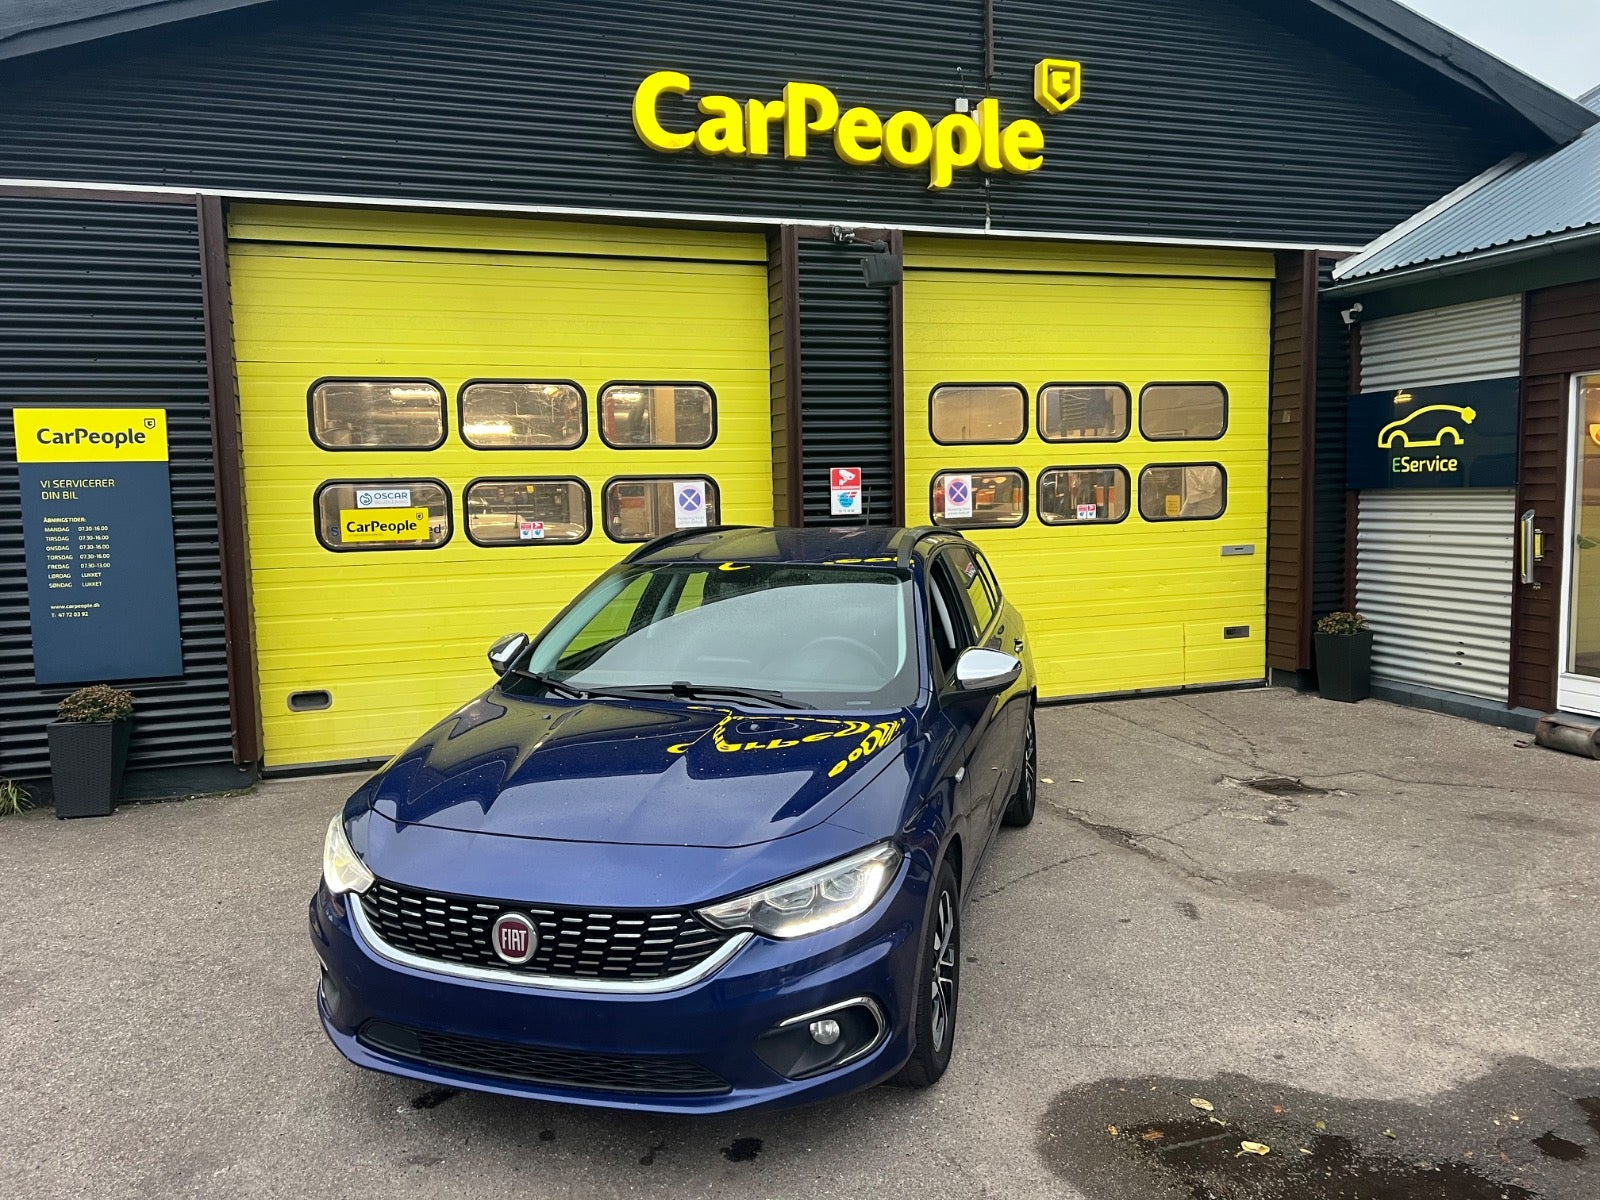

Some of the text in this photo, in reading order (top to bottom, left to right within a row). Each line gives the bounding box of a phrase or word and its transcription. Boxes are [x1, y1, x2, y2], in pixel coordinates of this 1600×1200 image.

[632, 71, 1044, 191] CarPeople
[36, 428, 146, 449] CarPeople
[1392, 455, 1458, 473] EService
[40, 479, 115, 488] VI SERVICERER
[41, 491, 78, 500] DIN BIL
[374, 492, 408, 500] OSCAR
[346, 520, 417, 534] CarPeople
[501, 928, 527, 952] FIAT
